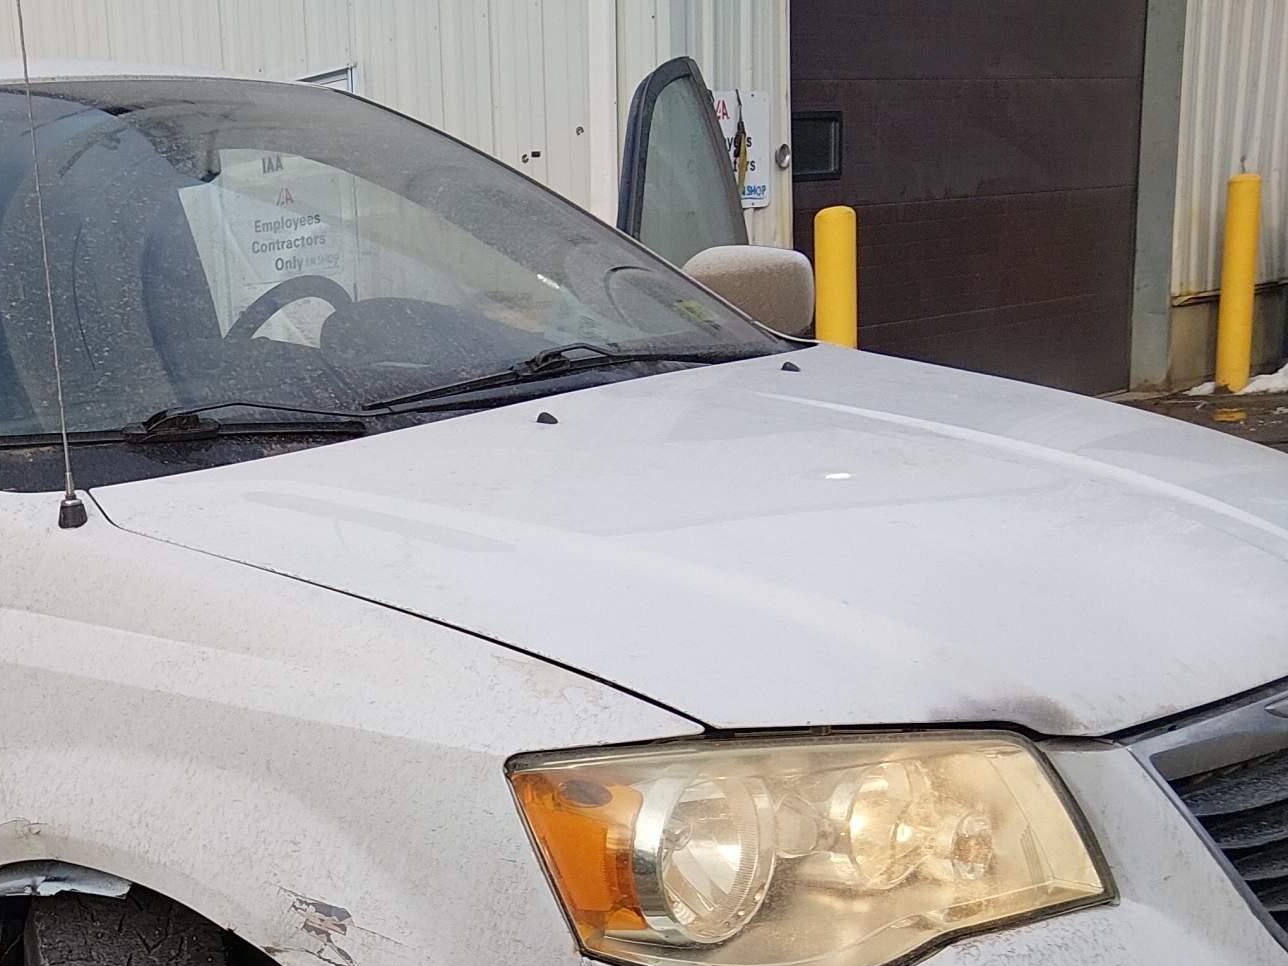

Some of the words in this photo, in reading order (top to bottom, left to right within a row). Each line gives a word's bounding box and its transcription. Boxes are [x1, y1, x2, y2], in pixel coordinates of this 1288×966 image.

[262, 156, 283, 174] IAA
[253, 213, 321, 234] Employees
[251, 234, 327, 254] Contractors
[274, 255, 303, 272] Only
